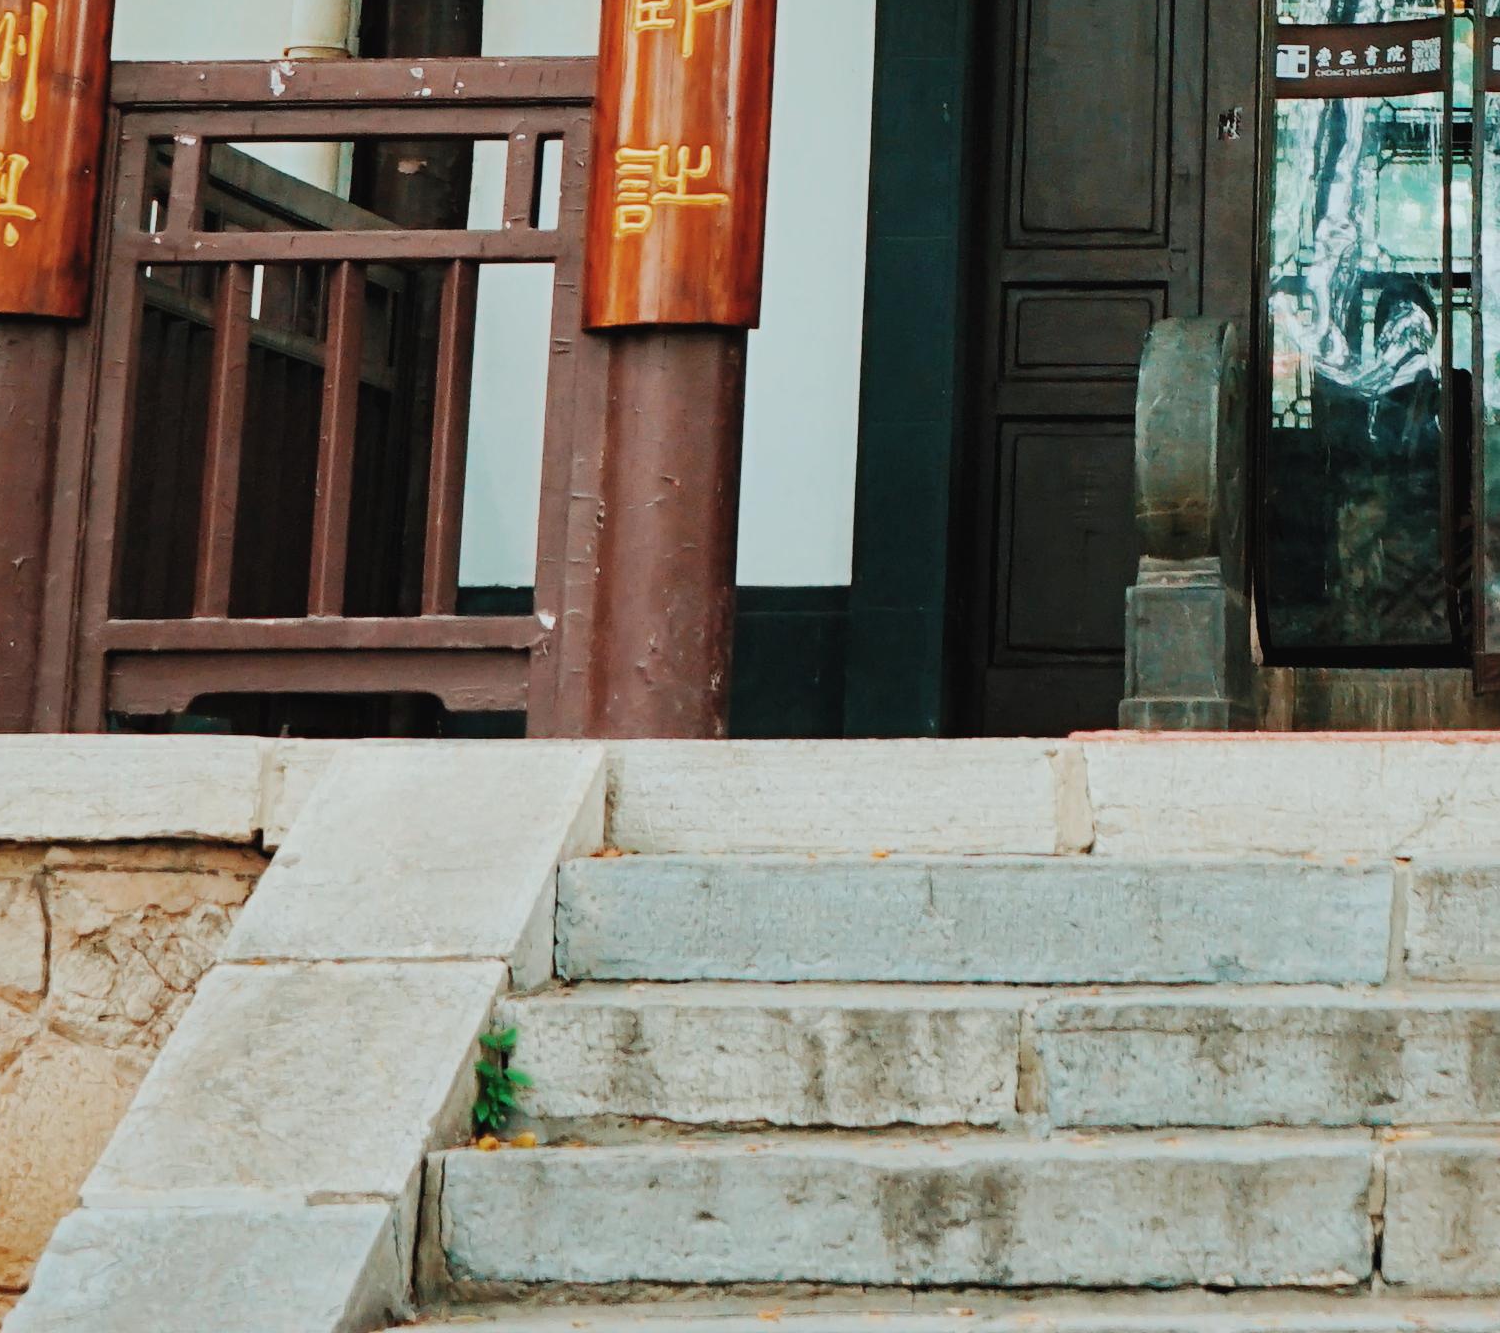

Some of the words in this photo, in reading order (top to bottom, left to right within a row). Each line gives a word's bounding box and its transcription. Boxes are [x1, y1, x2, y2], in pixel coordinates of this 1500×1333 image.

[1314, 69, 1345, 78] CHONG
[1345, 67, 1373, 77] ZHENG
[1373, 65, 1407, 76] ACADEMY
